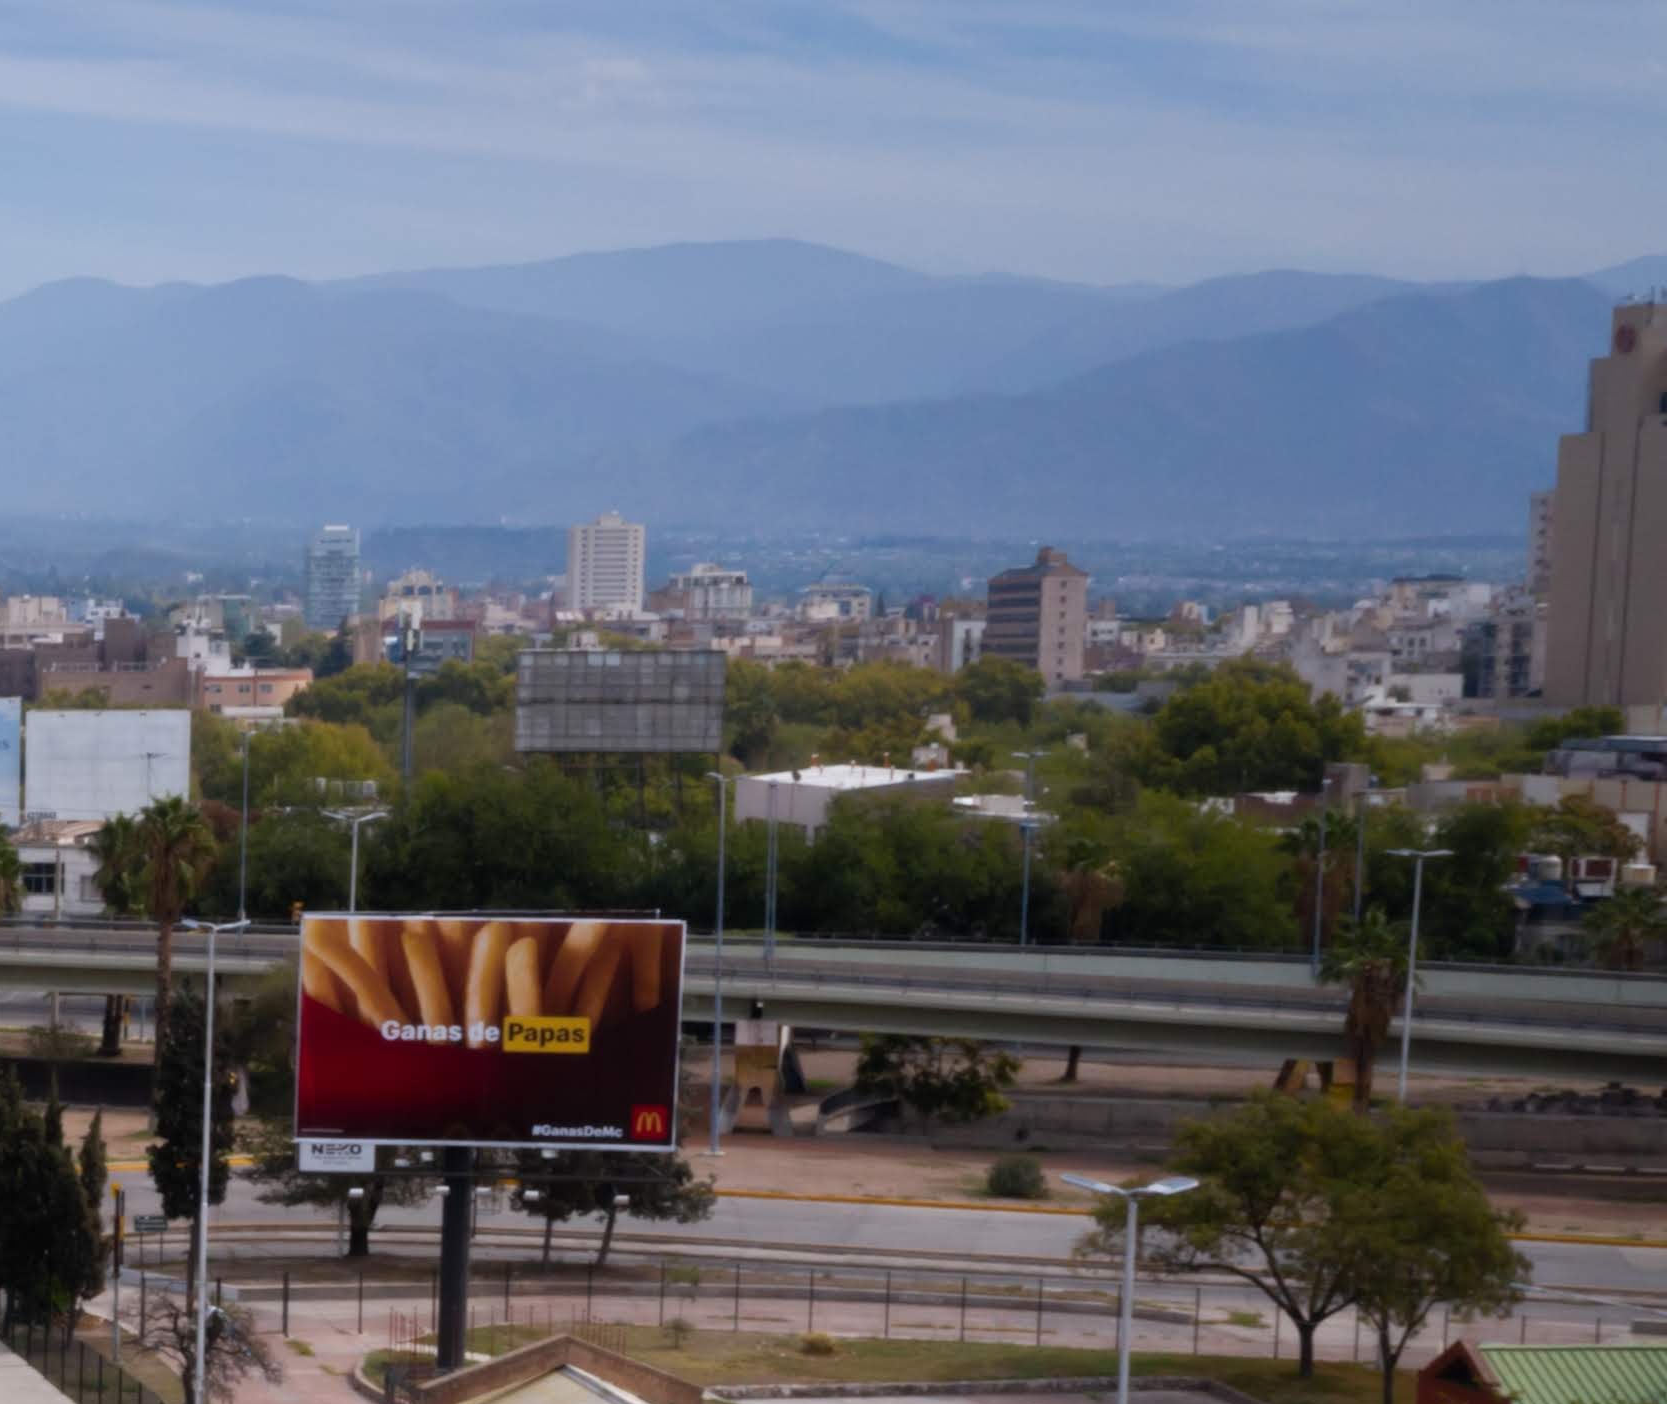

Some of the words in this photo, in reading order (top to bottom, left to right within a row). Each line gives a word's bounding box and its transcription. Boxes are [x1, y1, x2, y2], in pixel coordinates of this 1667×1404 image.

[380, 1019, 463, 1042] Ganas
[467, 1020, 501, 1042] de
[508, 1023, 585, 1047] Papas
[531, 1123, 624, 1138] #GanasDeMc
